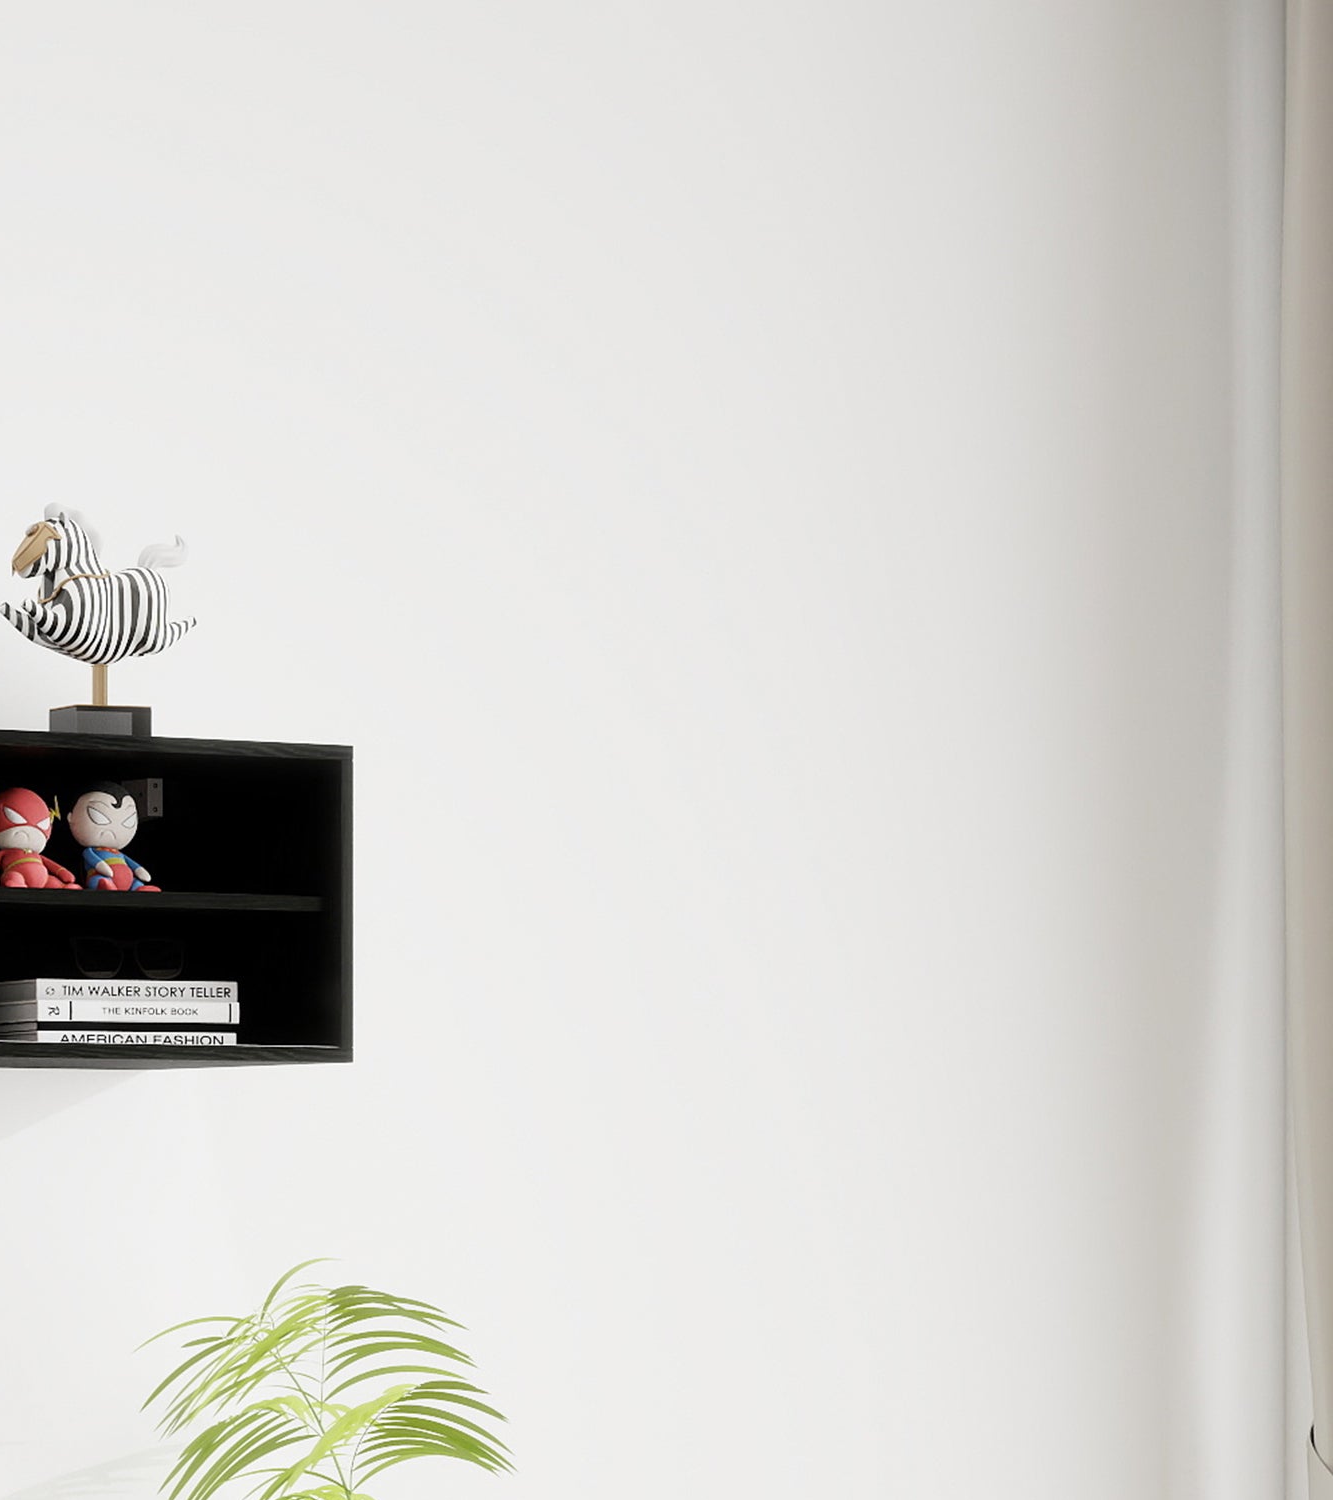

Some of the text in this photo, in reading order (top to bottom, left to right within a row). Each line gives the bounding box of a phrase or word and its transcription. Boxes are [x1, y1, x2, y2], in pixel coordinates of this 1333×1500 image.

[62, 985, 231, 998] TIM WALKER STORY TELLER
[102, 1007, 199, 1016] THE KINFOLK BOOK
[60, 1034, 224, 1045] AMERICAN FASHION
